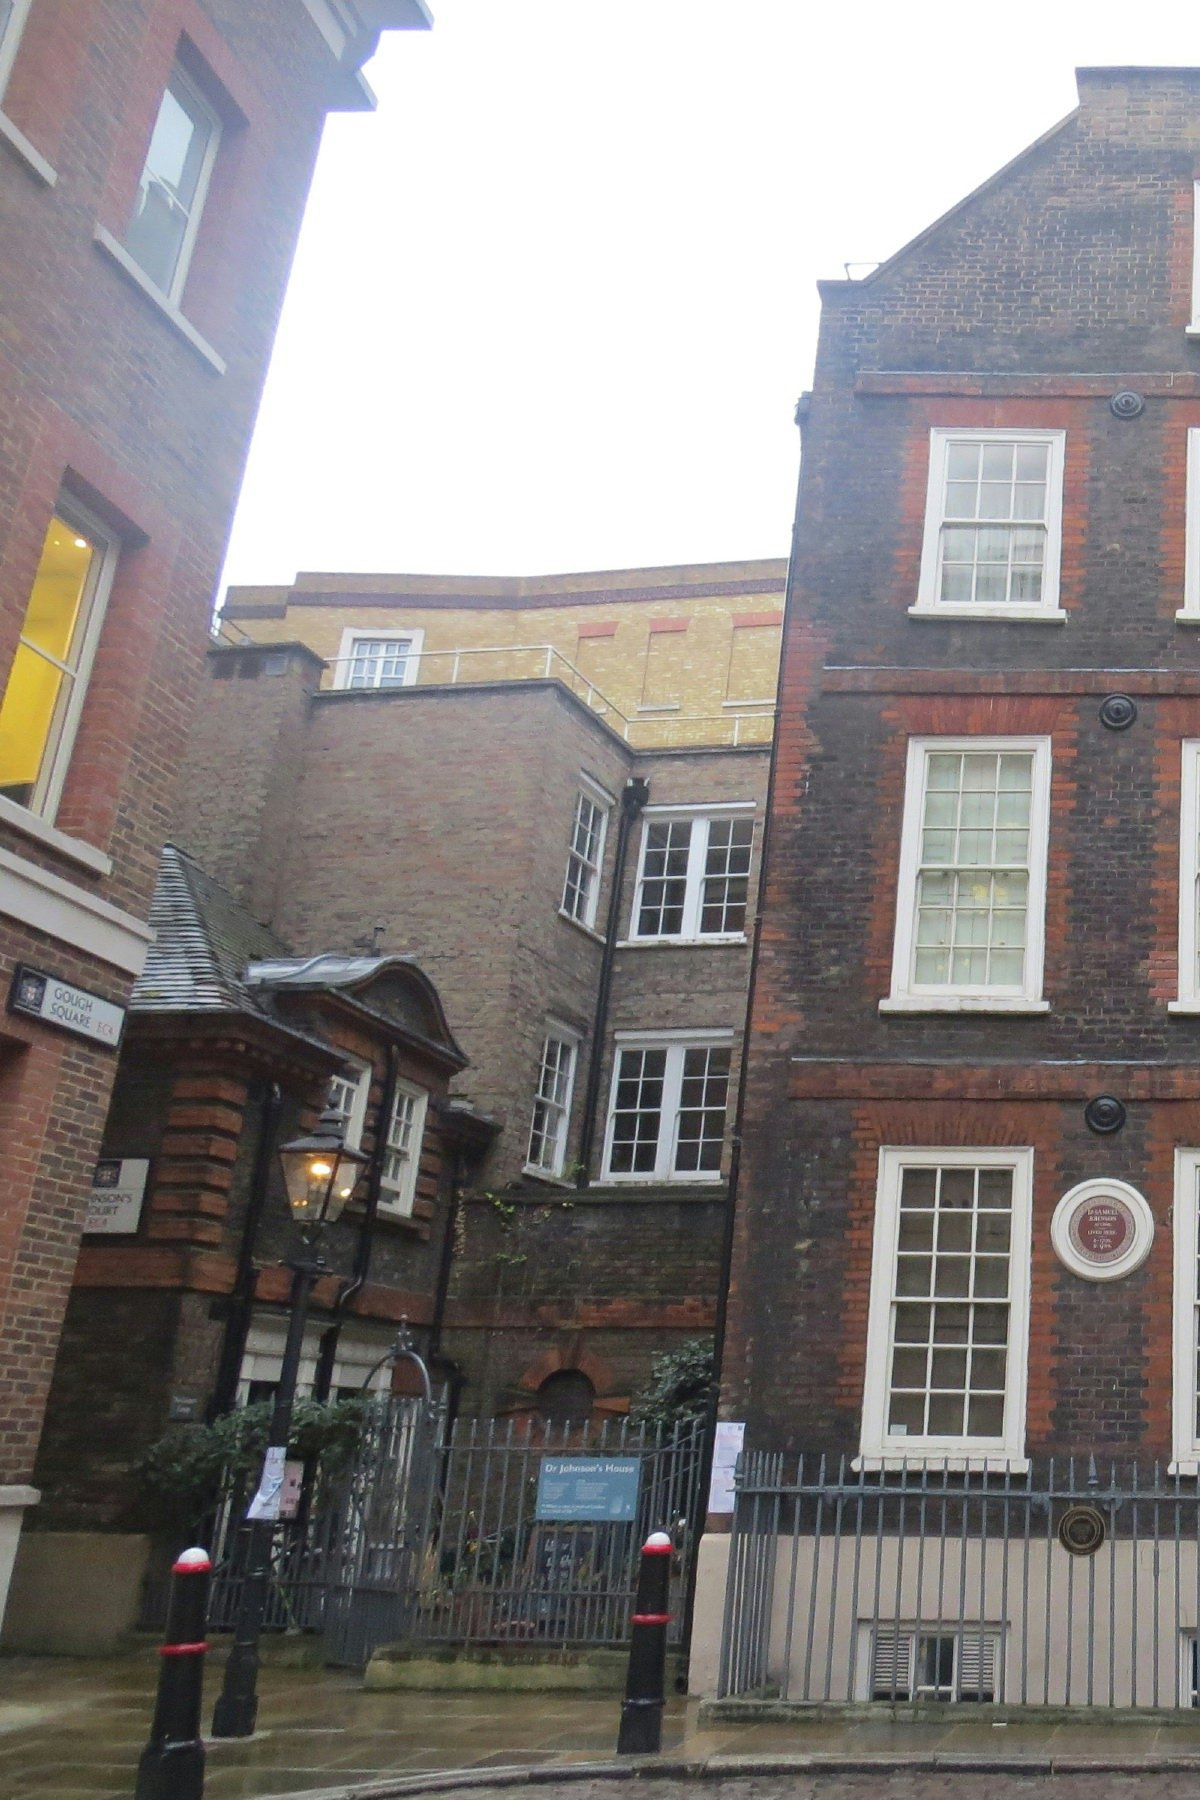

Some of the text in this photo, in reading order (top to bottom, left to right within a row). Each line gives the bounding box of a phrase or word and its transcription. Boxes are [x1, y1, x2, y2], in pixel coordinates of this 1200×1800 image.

[54, 987, 94, 1012] GOUGH
[49, 1002, 92, 1029] SQUARE
[89, 1193, 133, 1203] NSON'S
[545, 1464, 635, 1474] Dr Johnson's House
